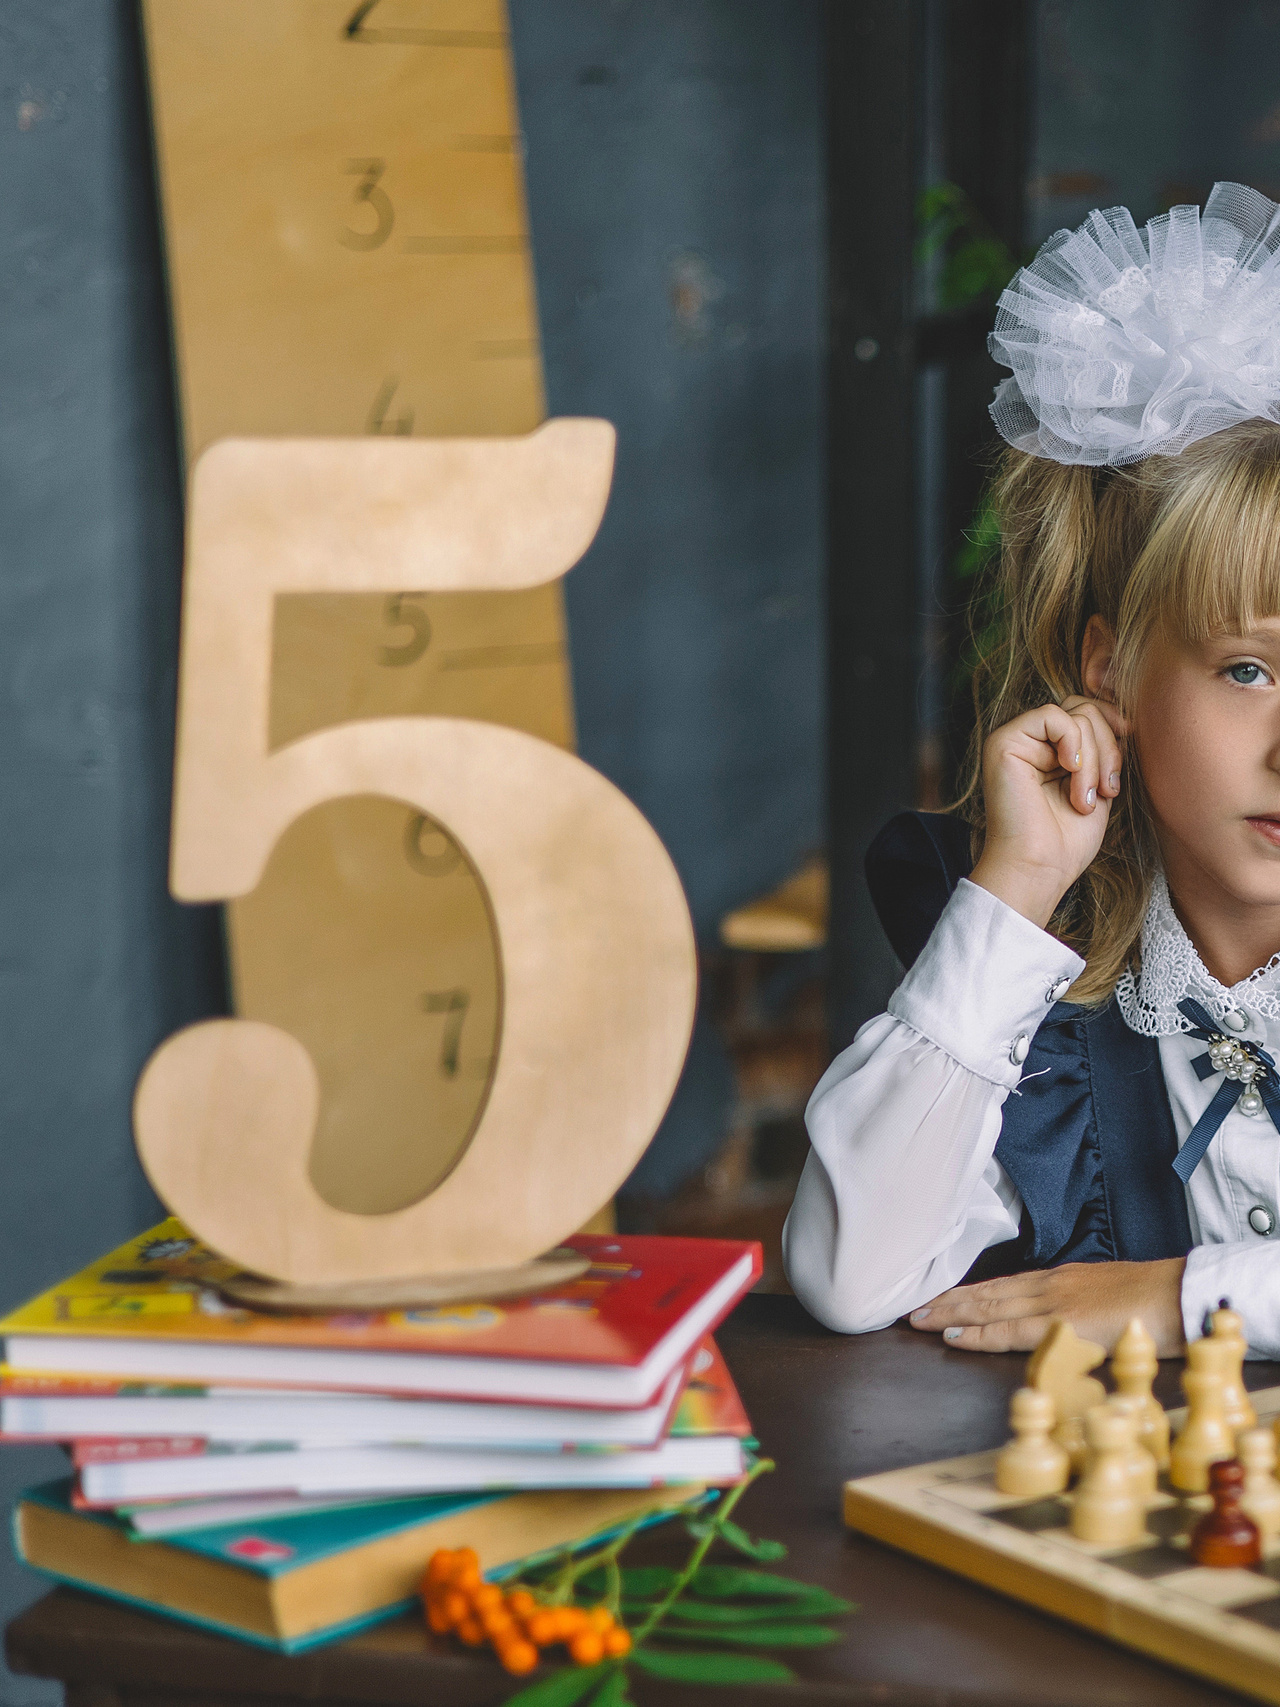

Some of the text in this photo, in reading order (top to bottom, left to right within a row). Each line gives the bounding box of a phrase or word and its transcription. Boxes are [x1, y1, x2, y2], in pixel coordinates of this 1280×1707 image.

[339, 156, 396, 253] 3
[377, 591, 433, 668] 5
[132, 416, 699, 1286] 5
[422, 989, 468, 1081] 7
